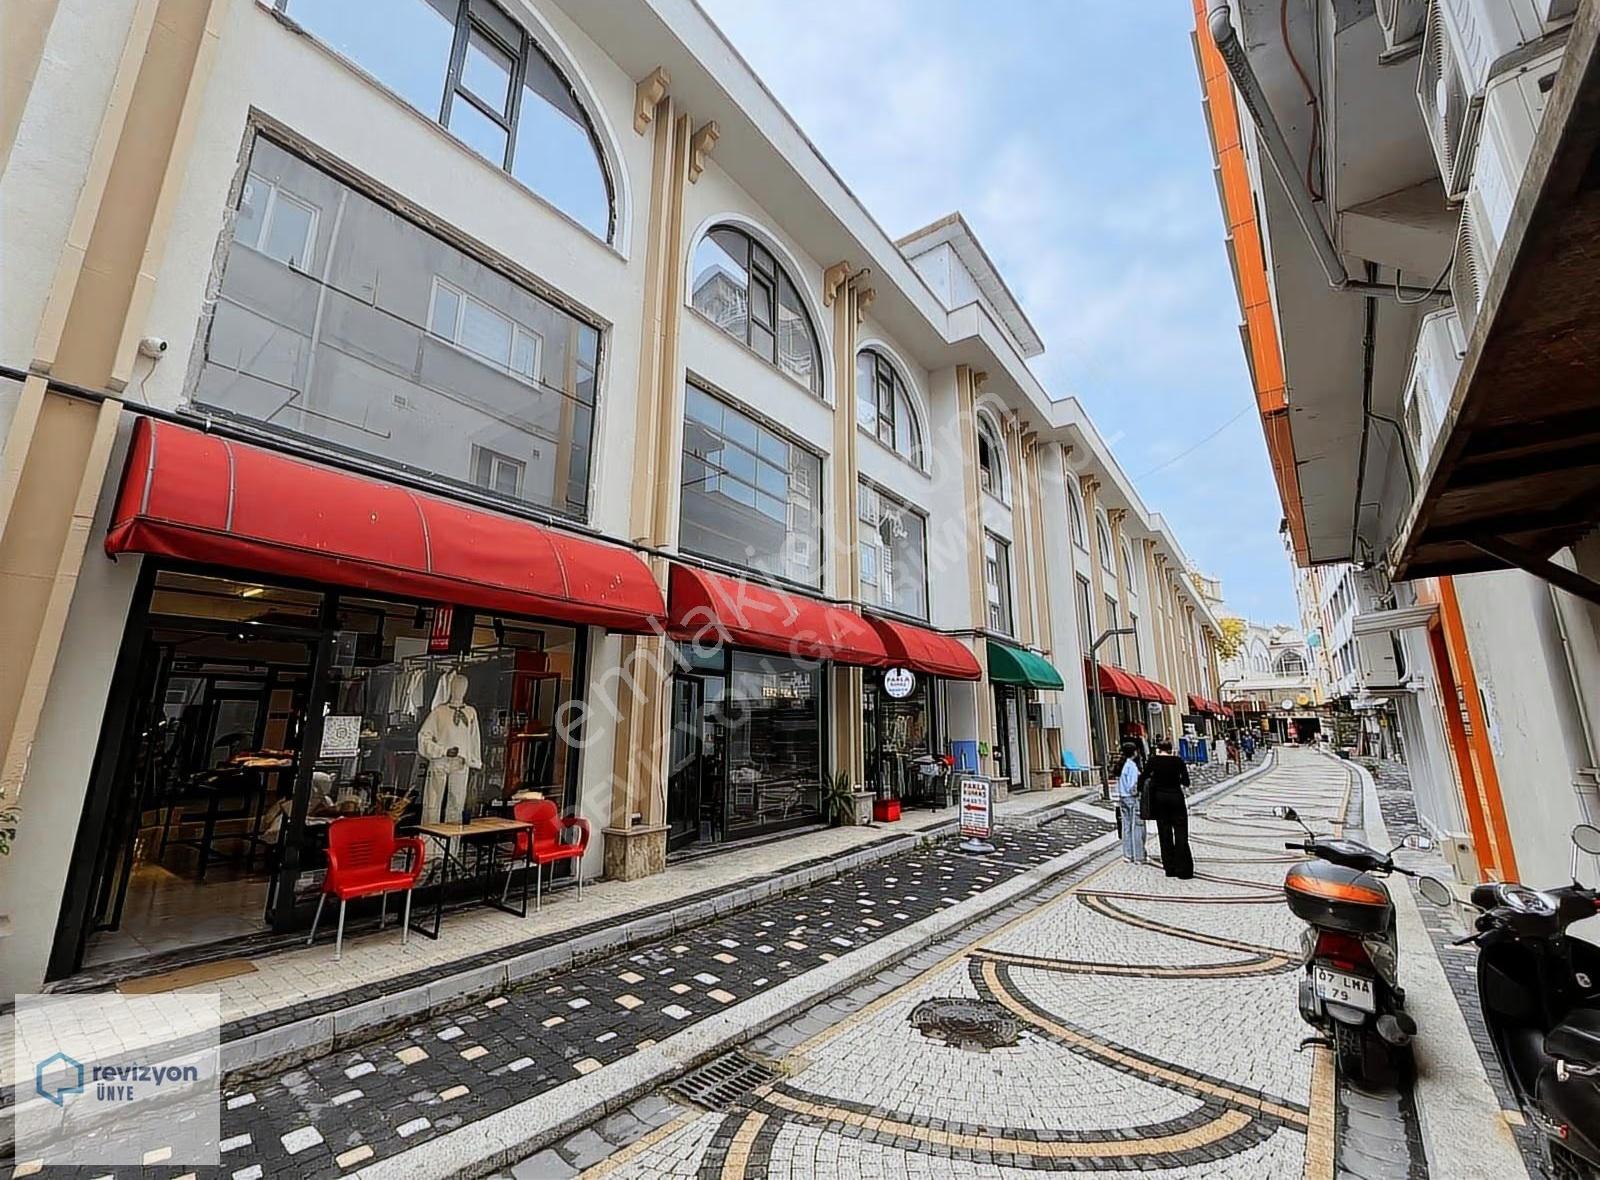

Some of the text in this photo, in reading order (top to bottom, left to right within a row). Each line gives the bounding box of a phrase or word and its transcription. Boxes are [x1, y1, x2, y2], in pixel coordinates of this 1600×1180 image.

[1319, 970, 1370, 993] 07 LMA
[1332, 988, 1349, 1000] 79
